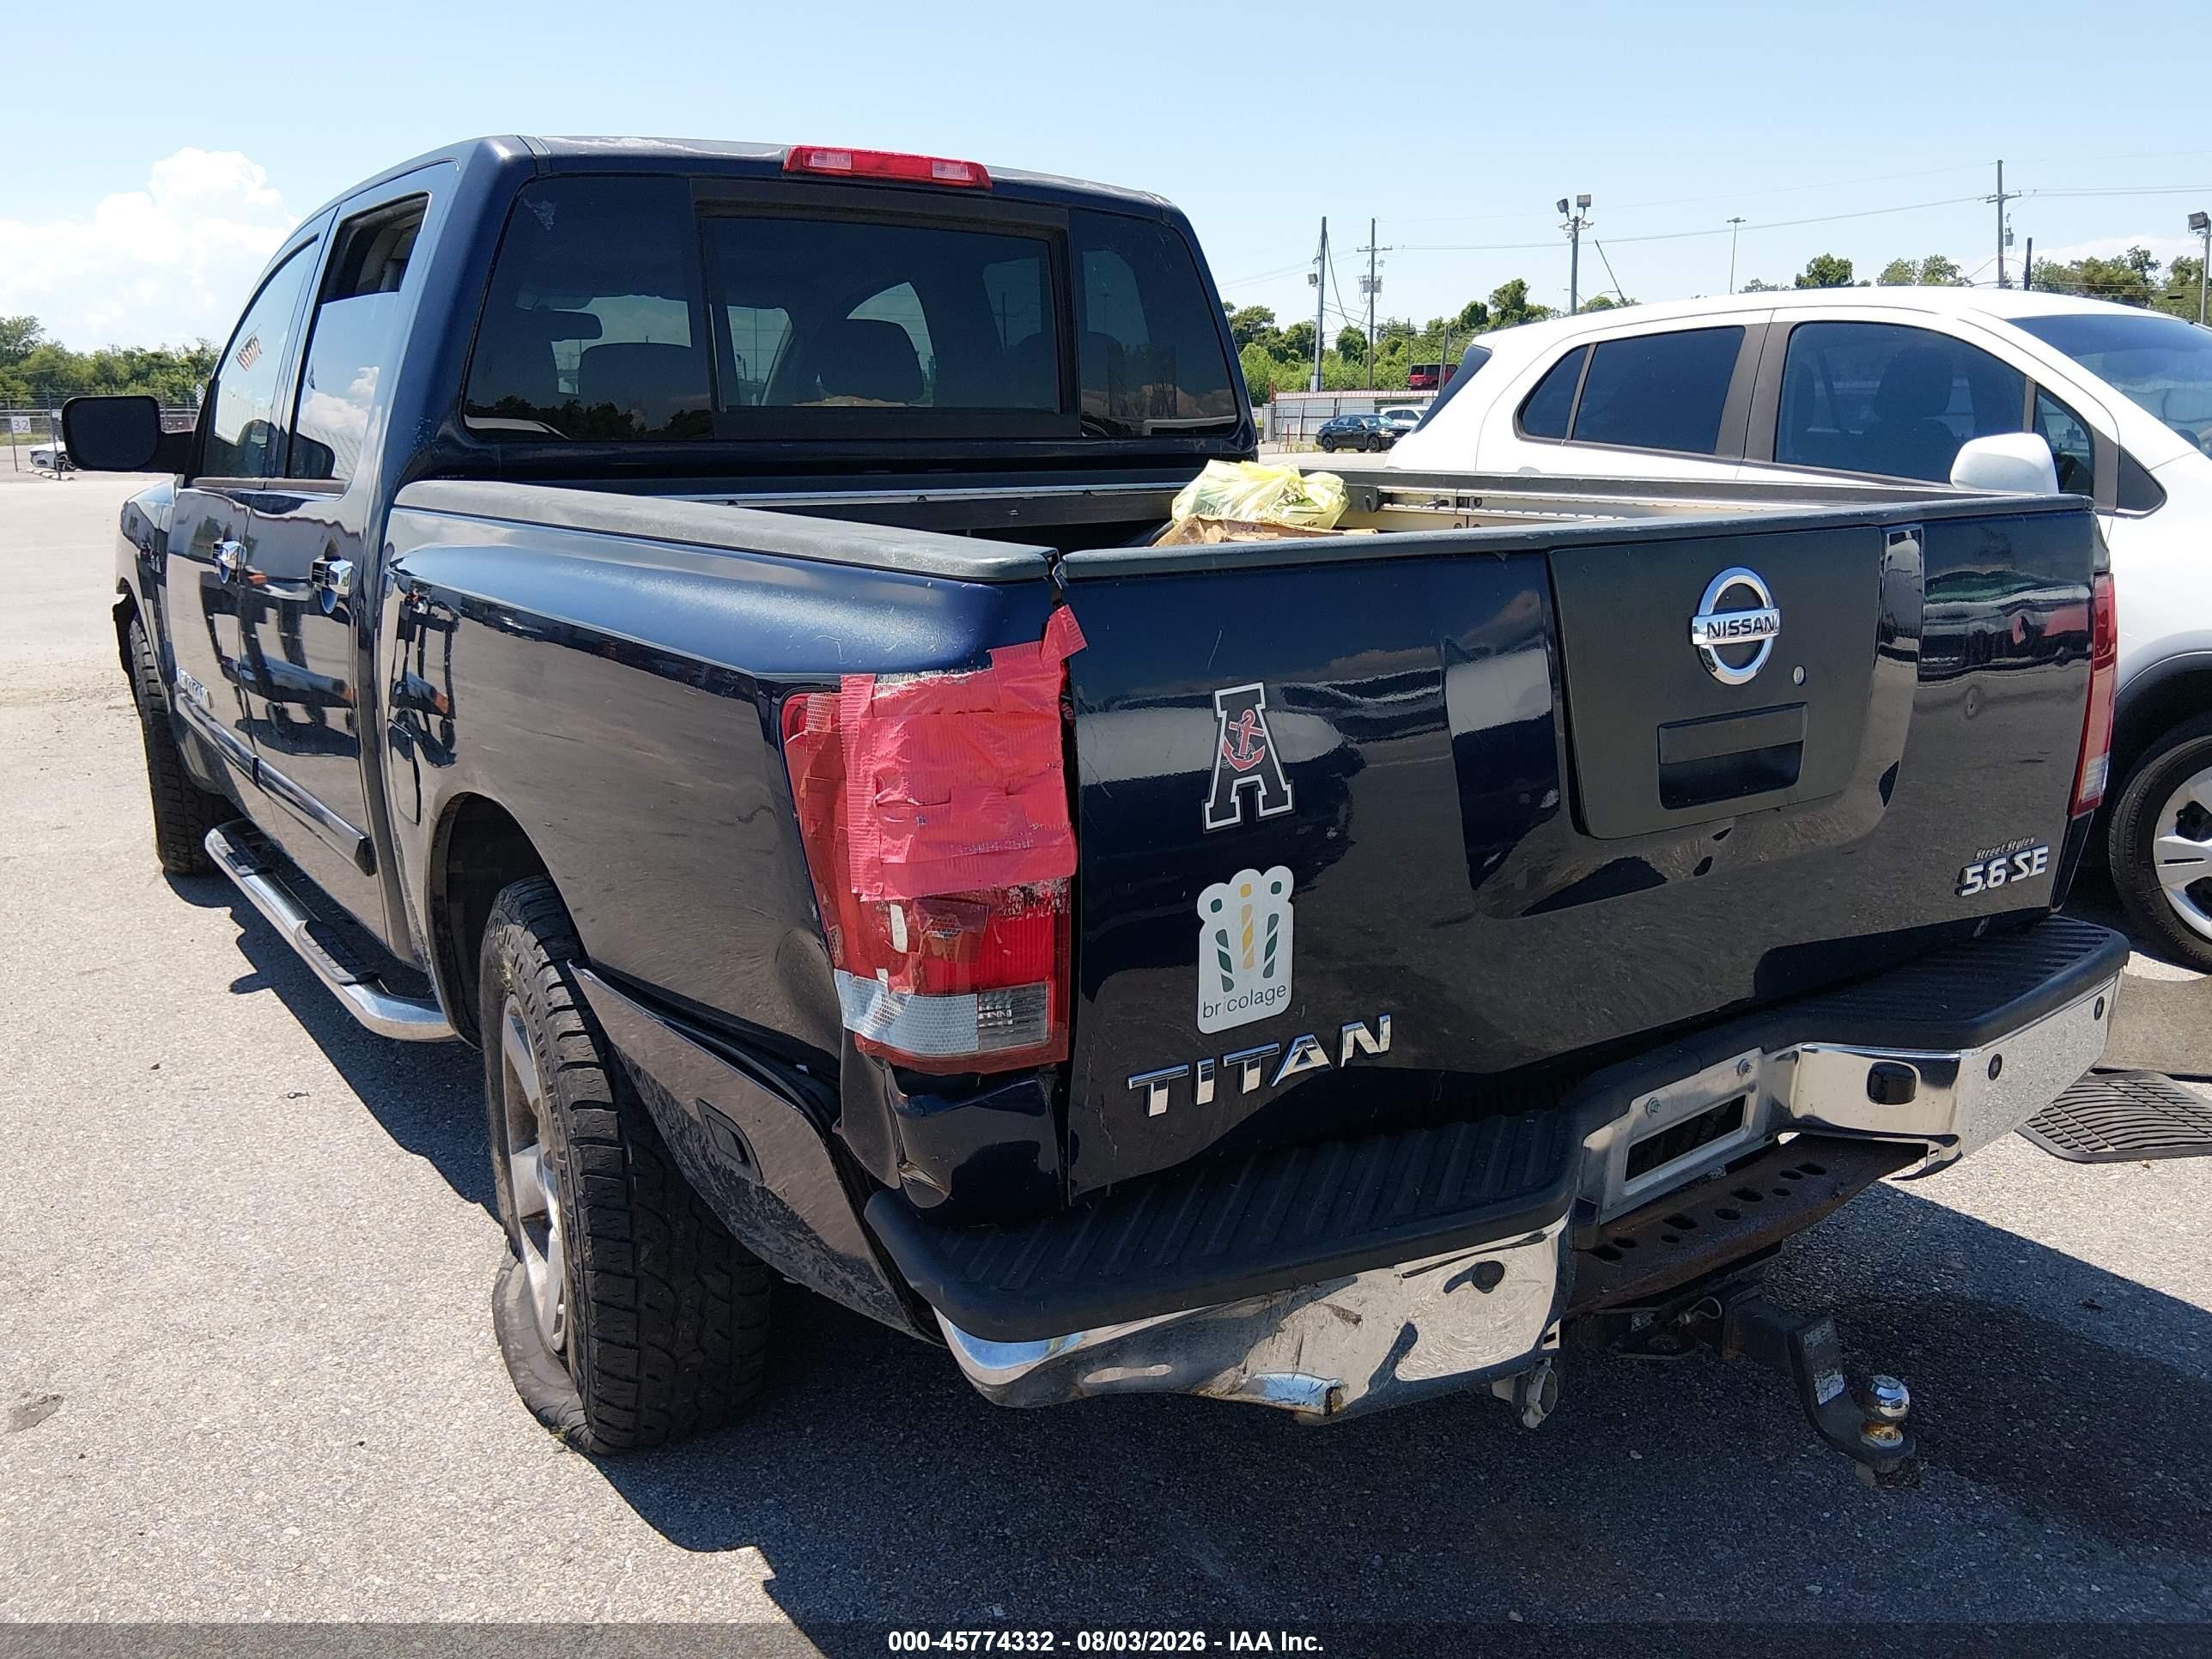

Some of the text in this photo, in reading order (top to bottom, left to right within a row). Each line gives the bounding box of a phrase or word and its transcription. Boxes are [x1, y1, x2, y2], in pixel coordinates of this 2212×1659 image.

[14, 420, 30, 431] 32
[1707, 615, 1775, 639] NISSAN
[2010, 847, 2049, 881] SE
[1127, 1013, 1392, 1118] TITAN
